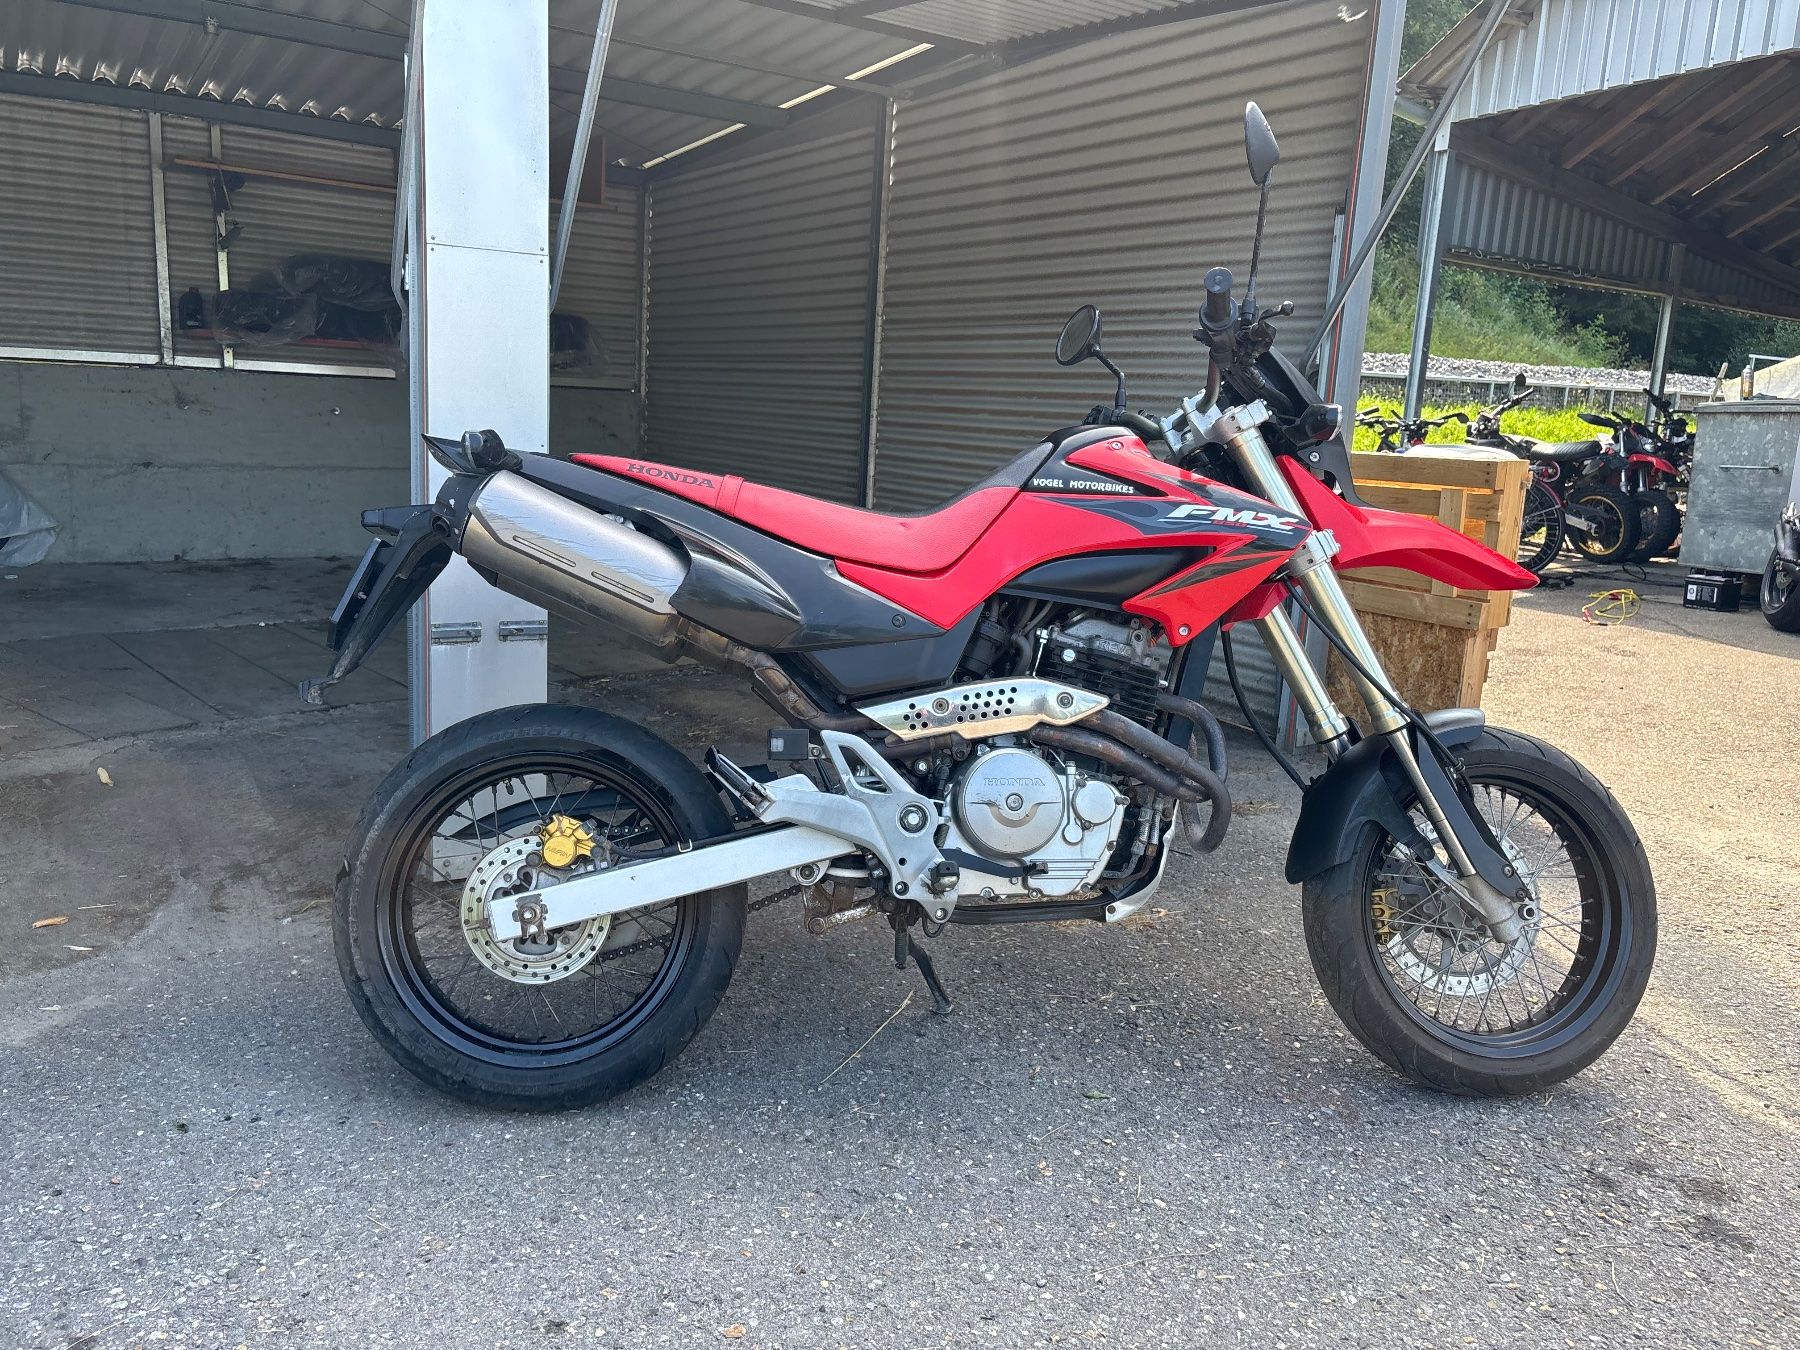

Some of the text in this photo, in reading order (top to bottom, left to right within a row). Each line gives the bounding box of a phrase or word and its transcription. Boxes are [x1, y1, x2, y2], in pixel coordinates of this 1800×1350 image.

[626, 463, 715, 488] HONDA
[1033, 478, 1134, 494] VOGEL MOTORBIKES
[1165, 504, 1299, 531] FMX
[983, 777, 1046, 787] HONDA
